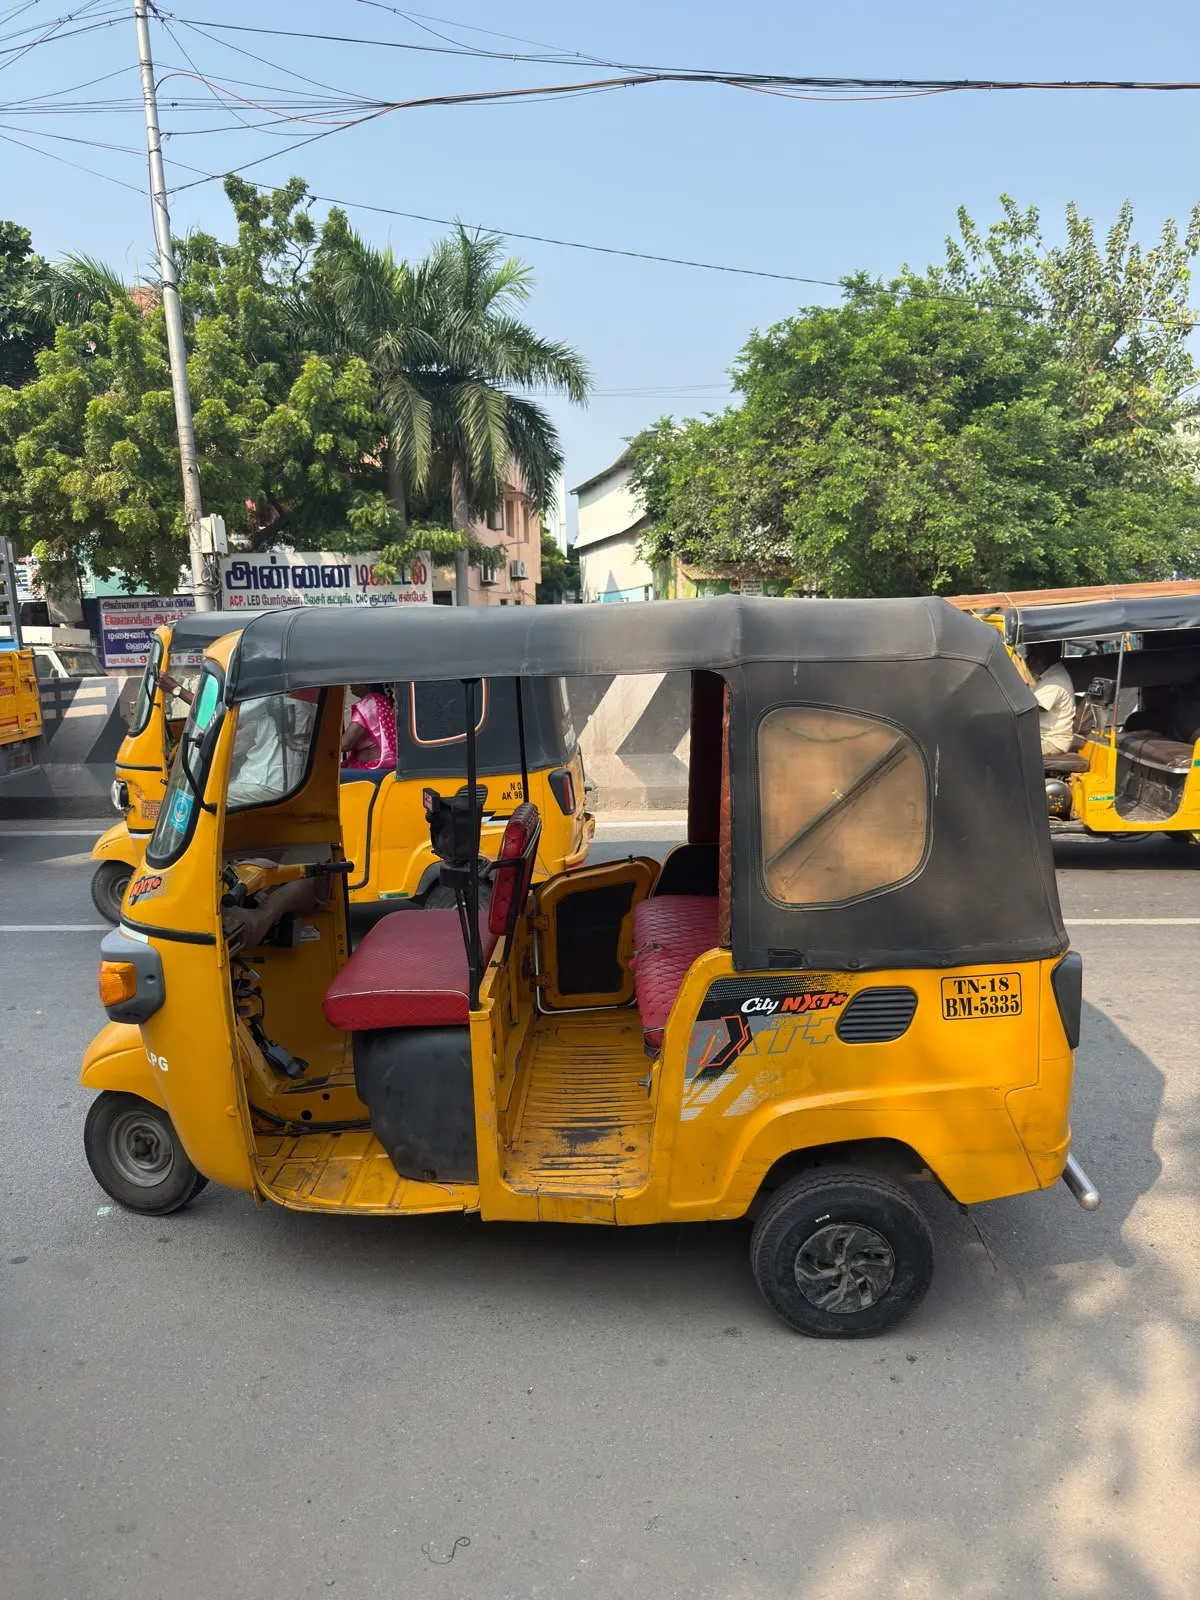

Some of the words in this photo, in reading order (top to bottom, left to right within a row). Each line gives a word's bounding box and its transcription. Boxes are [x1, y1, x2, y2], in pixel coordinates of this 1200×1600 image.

[225, 556, 351, 589] அன்னை
[247, 595, 260, 605] LED
[356, 594, 367, 603] CNC
[953, 977, 1010, 994] TN-18
[740, 997, 780, 1015] City
[945, 994, 1020, 1017] BM-5335
